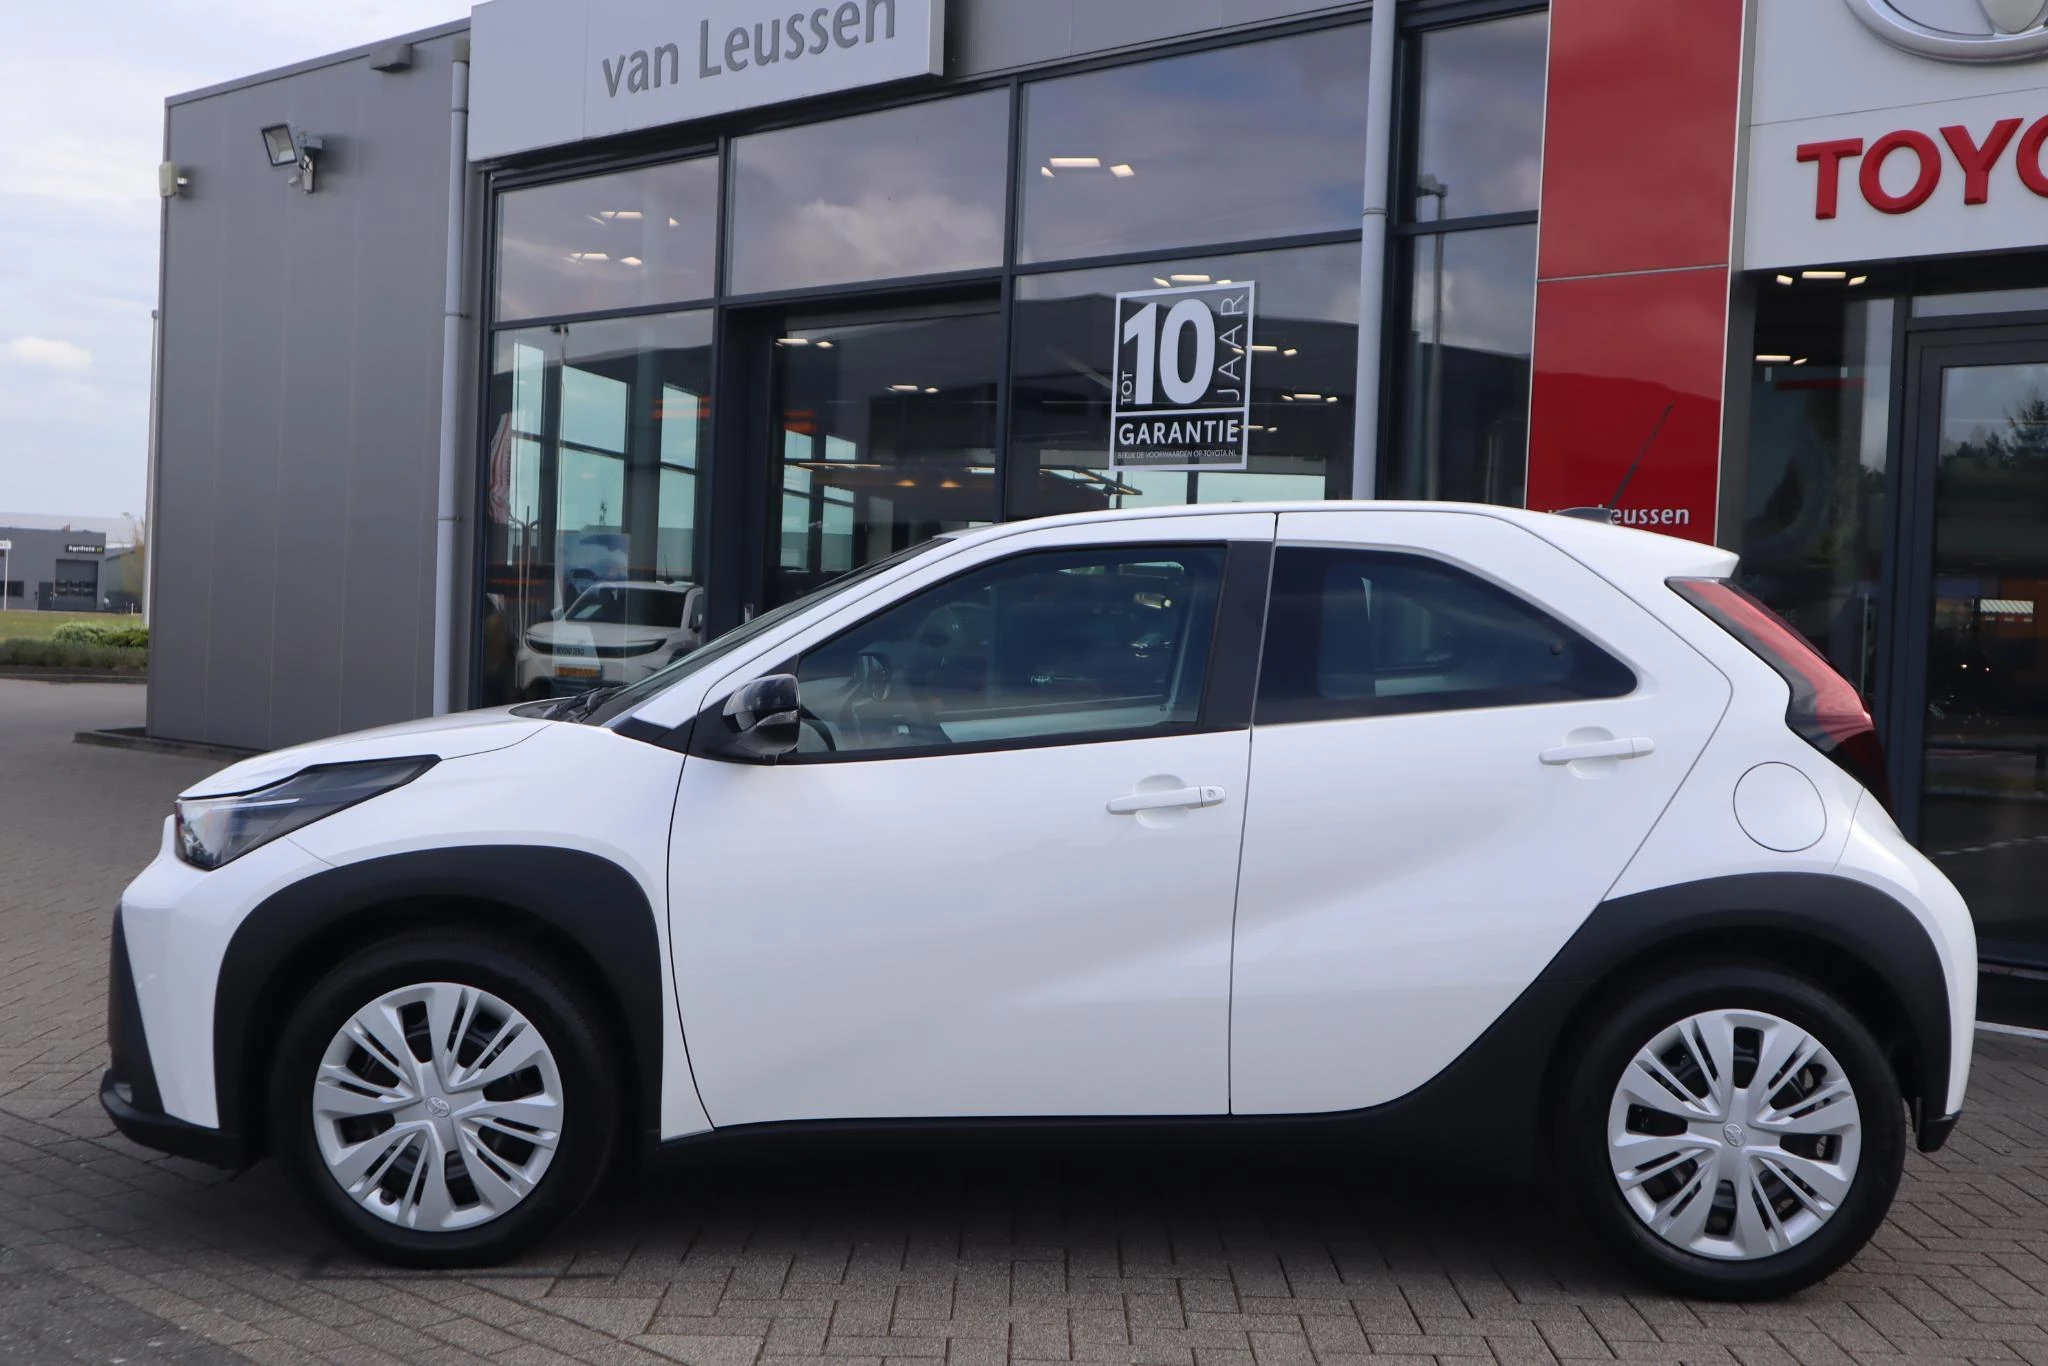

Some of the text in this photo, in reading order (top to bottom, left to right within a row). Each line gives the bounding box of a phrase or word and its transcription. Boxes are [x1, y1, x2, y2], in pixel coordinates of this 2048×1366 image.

[602, 0, 896, 97] van Leussen
[1123, 298, 1216, 405] 10
[1217, 294, 1244, 402] JAAR
[1121, 370, 1133, 406] TOT
[1118, 419, 1239, 446] GARANTIE
[1145, 450, 1193, 459] VOORWAARDEN
[1598, 504, 1690, 525] eussen
